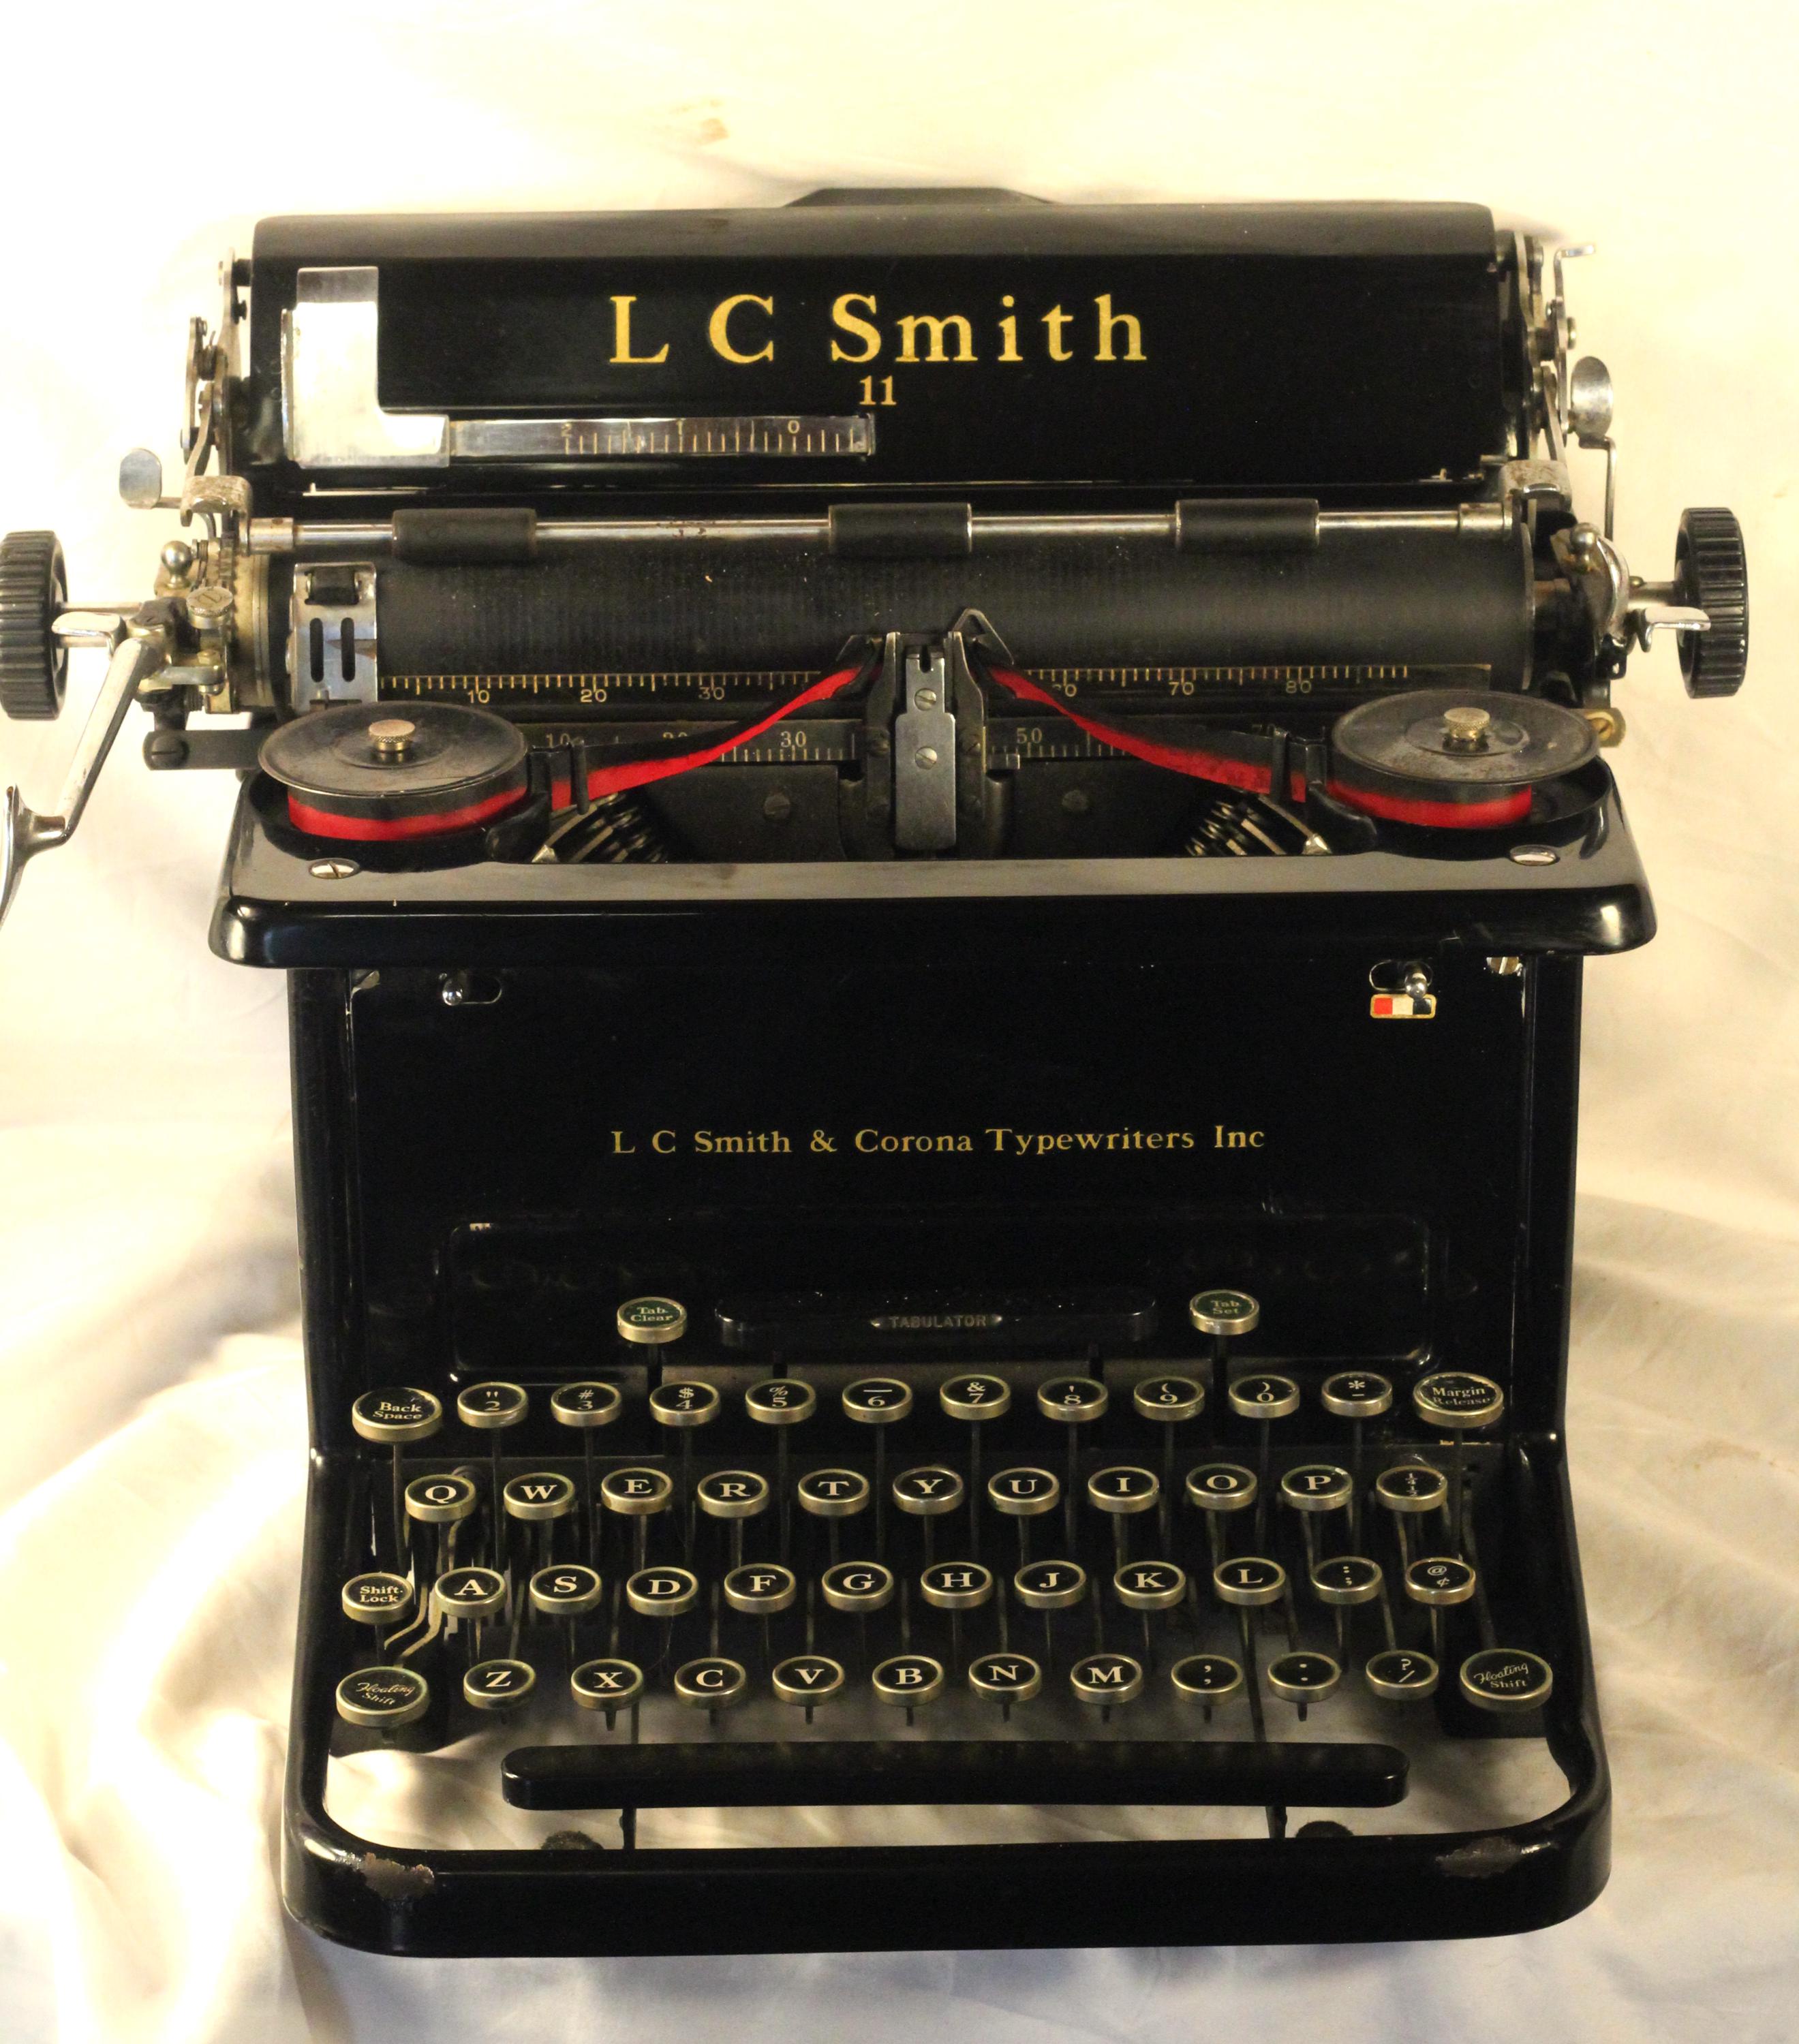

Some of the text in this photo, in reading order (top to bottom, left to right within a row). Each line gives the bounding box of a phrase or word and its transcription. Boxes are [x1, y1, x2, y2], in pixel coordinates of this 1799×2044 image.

[609, 293, 1147, 364] L C Smith
[859, 375, 897, 406] 11
[560, 422, 573, 437] 2
[787, 420, 801, 434] 0
[467, 690, 490, 704] 10
[580, 687, 607, 703] 20
[698, 685, 725, 700] 30
[1168, 681, 1195, 696] 70
[1285, 678, 1312, 694] 80
[780, 731, 807, 749] 30
[1016, 728, 1043, 744] 50
[611, 1125, 1265, 1156] L C Smith & Corona Typewriters Inc
[636, 1306, 666, 1314] Tab
[630, 1314, 673, 1322] Clear
[889, 1316, 987, 1328] TABULATOR
[578, 1389, 594, 1400] #
[678, 1387, 694, 1399] $
[769, 1386, 788, 1397] %
[966, 1382, 986, 1393] &
[1432, 1387, 1486, 1397] Margin
[485, 1401, 501, 1411] 2
[577, 1401, 594, 1410] 3
[675, 1399, 693, 1410] 4
[771, 1397, 787, 1408] 5
[867, 1395, 885, 1407] 6
[968, 1393, 983, 1404] 7
[1063, 1395, 1082, 1405] 8
[1160, 1394, 1178, 1404] 9
[1432, 1397, 1491, 1406] Release
[380, 1402, 421, 1413] Back
[372, 1411, 422, 1421] Space
[624, 1478, 653, 1494] E
[818, 1481, 850, 1496] T
[912, 1478, 943, 1494] Y
[1010, 1479, 1038, 1494] U
[1116, 1477, 1131, 1492] I
[1206, 1474, 1238, 1490] O
[1304, 1475, 1332, 1491] P
[425, 1485, 457, 1504] Q
[520, 1484, 557, 1500] W
[719, 1483, 751, 1498] R
[1237, 1568, 1263, 1584] L
[1426, 1565, 1447, 1577] @
[454, 1579, 489, 1596] A
[553, 1576, 577, 1593] S
[647, 1579, 681, 1595] D
[750, 1575, 777, 1592] F
[842, 1573, 876, 1591] G
[941, 1572, 973, 1588] H
[1039, 1572, 1060, 1588] J
[1135, 1572, 1166, 1588] K
[359, 1585, 400, 1595] Shift
[359, 1595, 399, 1603] Lock
[1400, 1658, 1412, 1671] ?
[485, 1671, 512, 1688] Z
[594, 1671, 624, 1688] X
[696, 1669, 724, 1688] C
[795, 1669, 825, 1684] V
[895, 1667, 923, 1685] B
[989, 1664, 1019, 1681] N
[1088, 1666, 1124, 1684] M
[1398, 1671, 1415, 1683] /
[1473, 1662, 1529, 1683] Floating
[356, 1682, 415, 1697] Floating
[1490, 1680, 1527, 1689] Shift
[361, 1692, 396, 1705] Shift
